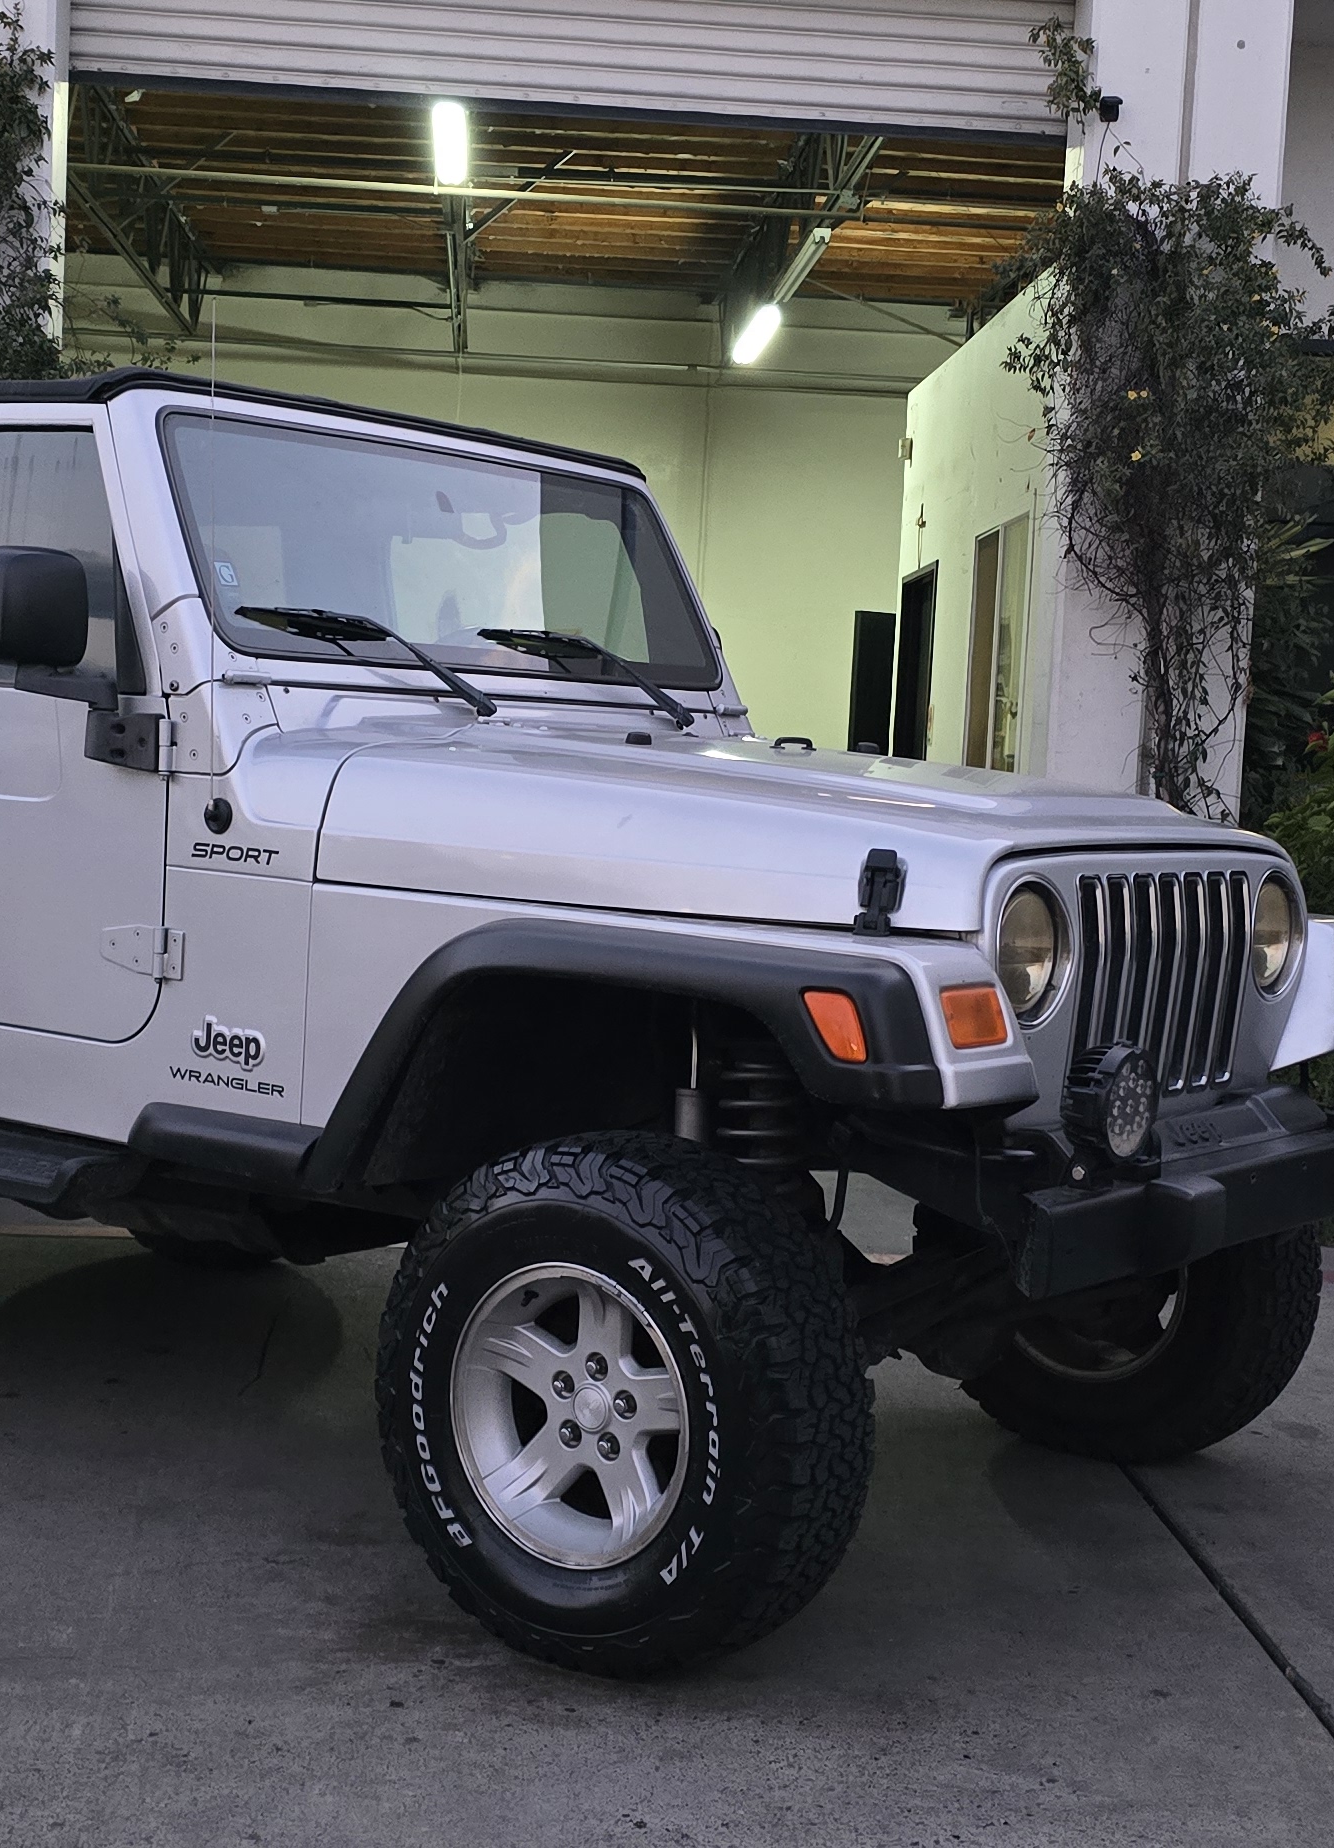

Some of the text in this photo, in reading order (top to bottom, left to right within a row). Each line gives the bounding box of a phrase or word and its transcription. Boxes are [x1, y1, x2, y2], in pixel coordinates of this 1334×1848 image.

[219, 565, 234, 583] G
[191, 842, 279, 866] SPORT
[192, 1018, 264, 1069] Jeep
[169, 1066, 285, 1098] WRANGLER
[409, 1281, 474, 1548] BFGoodrich
[627, 1257, 722, 1586] All-Terrain T/A
